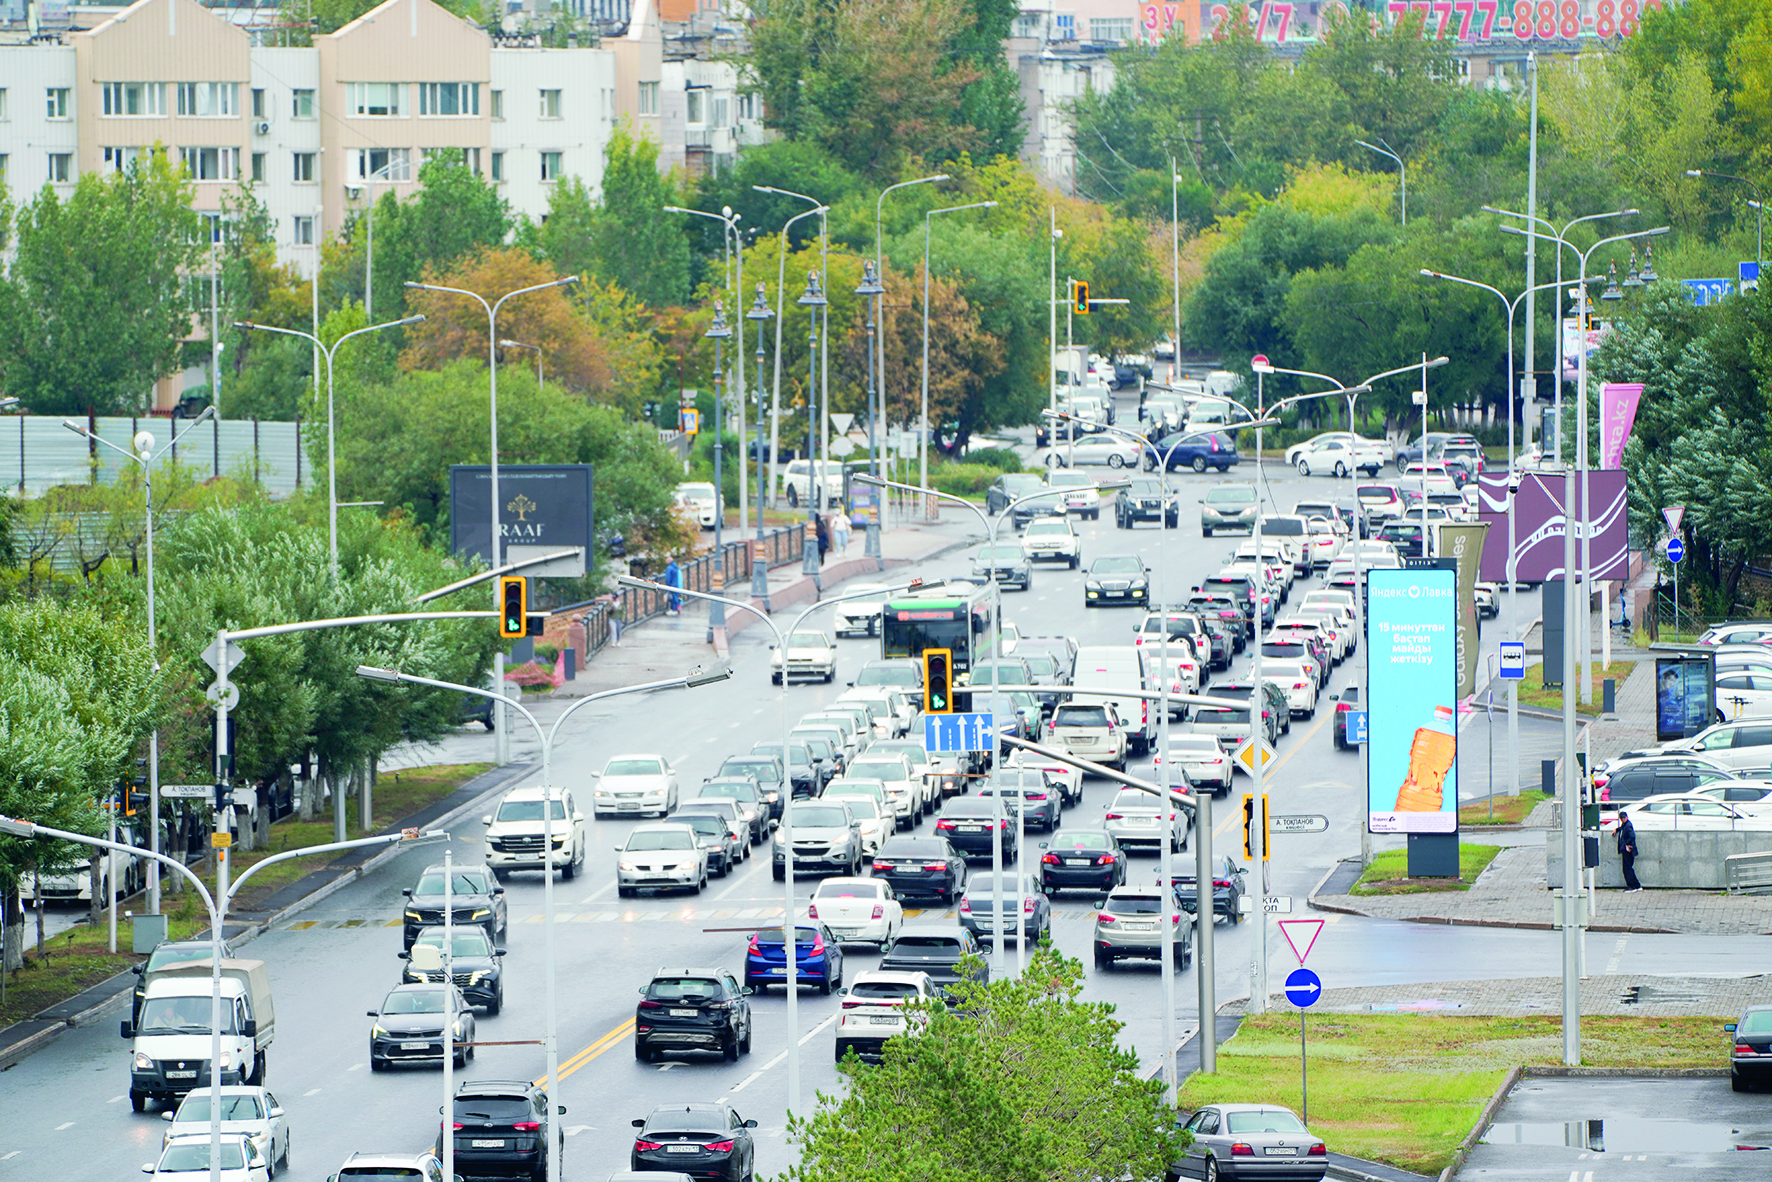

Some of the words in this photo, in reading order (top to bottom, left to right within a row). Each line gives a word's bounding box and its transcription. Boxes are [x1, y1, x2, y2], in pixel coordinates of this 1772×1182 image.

[498, 523, 545, 537] RAAF
[1371, 586, 1407, 598] Яндекс
[1422, 586, 1453, 597] Лавка
[1378, 622, 1390, 632] 15
[1391, 623, 1446, 634] минуттан
[1393, 634, 1431, 643] бастап
[1392, 643, 1432, 654] майды
[1390, 655, 1433, 665] жеткізу
